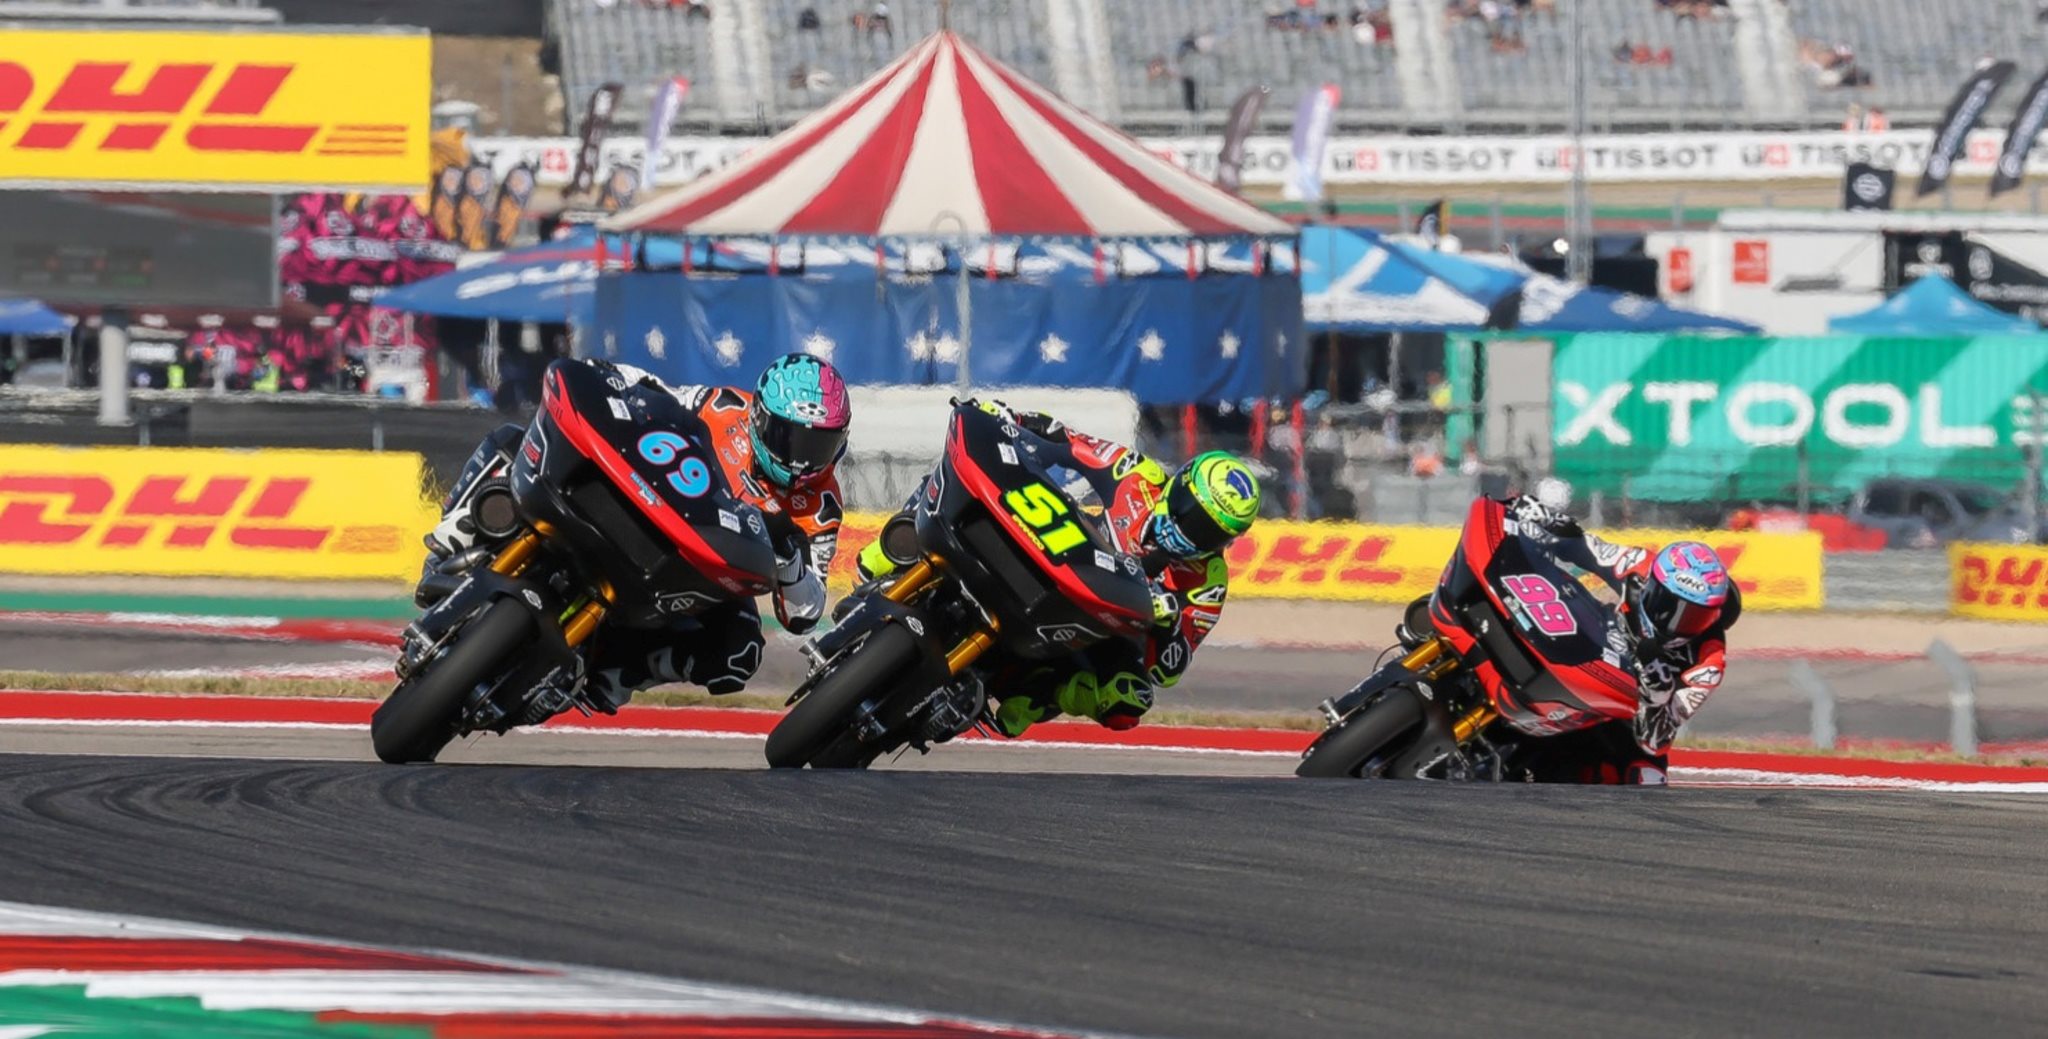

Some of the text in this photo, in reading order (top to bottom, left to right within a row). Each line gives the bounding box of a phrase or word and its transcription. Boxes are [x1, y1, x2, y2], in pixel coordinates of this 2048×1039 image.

[0, 62, 321, 152] HL
[1388, 146, 1516, 171] TISSOT
[1593, 145, 1717, 168] TISSOT
[1555, 382, 1997, 447] XTOOL
[638, 431, 710, 498] 69
[1005, 482, 1088, 555] 51
[1209, 485, 1237, 517] SHARK
[1500, 573, 1578, 636] 99
